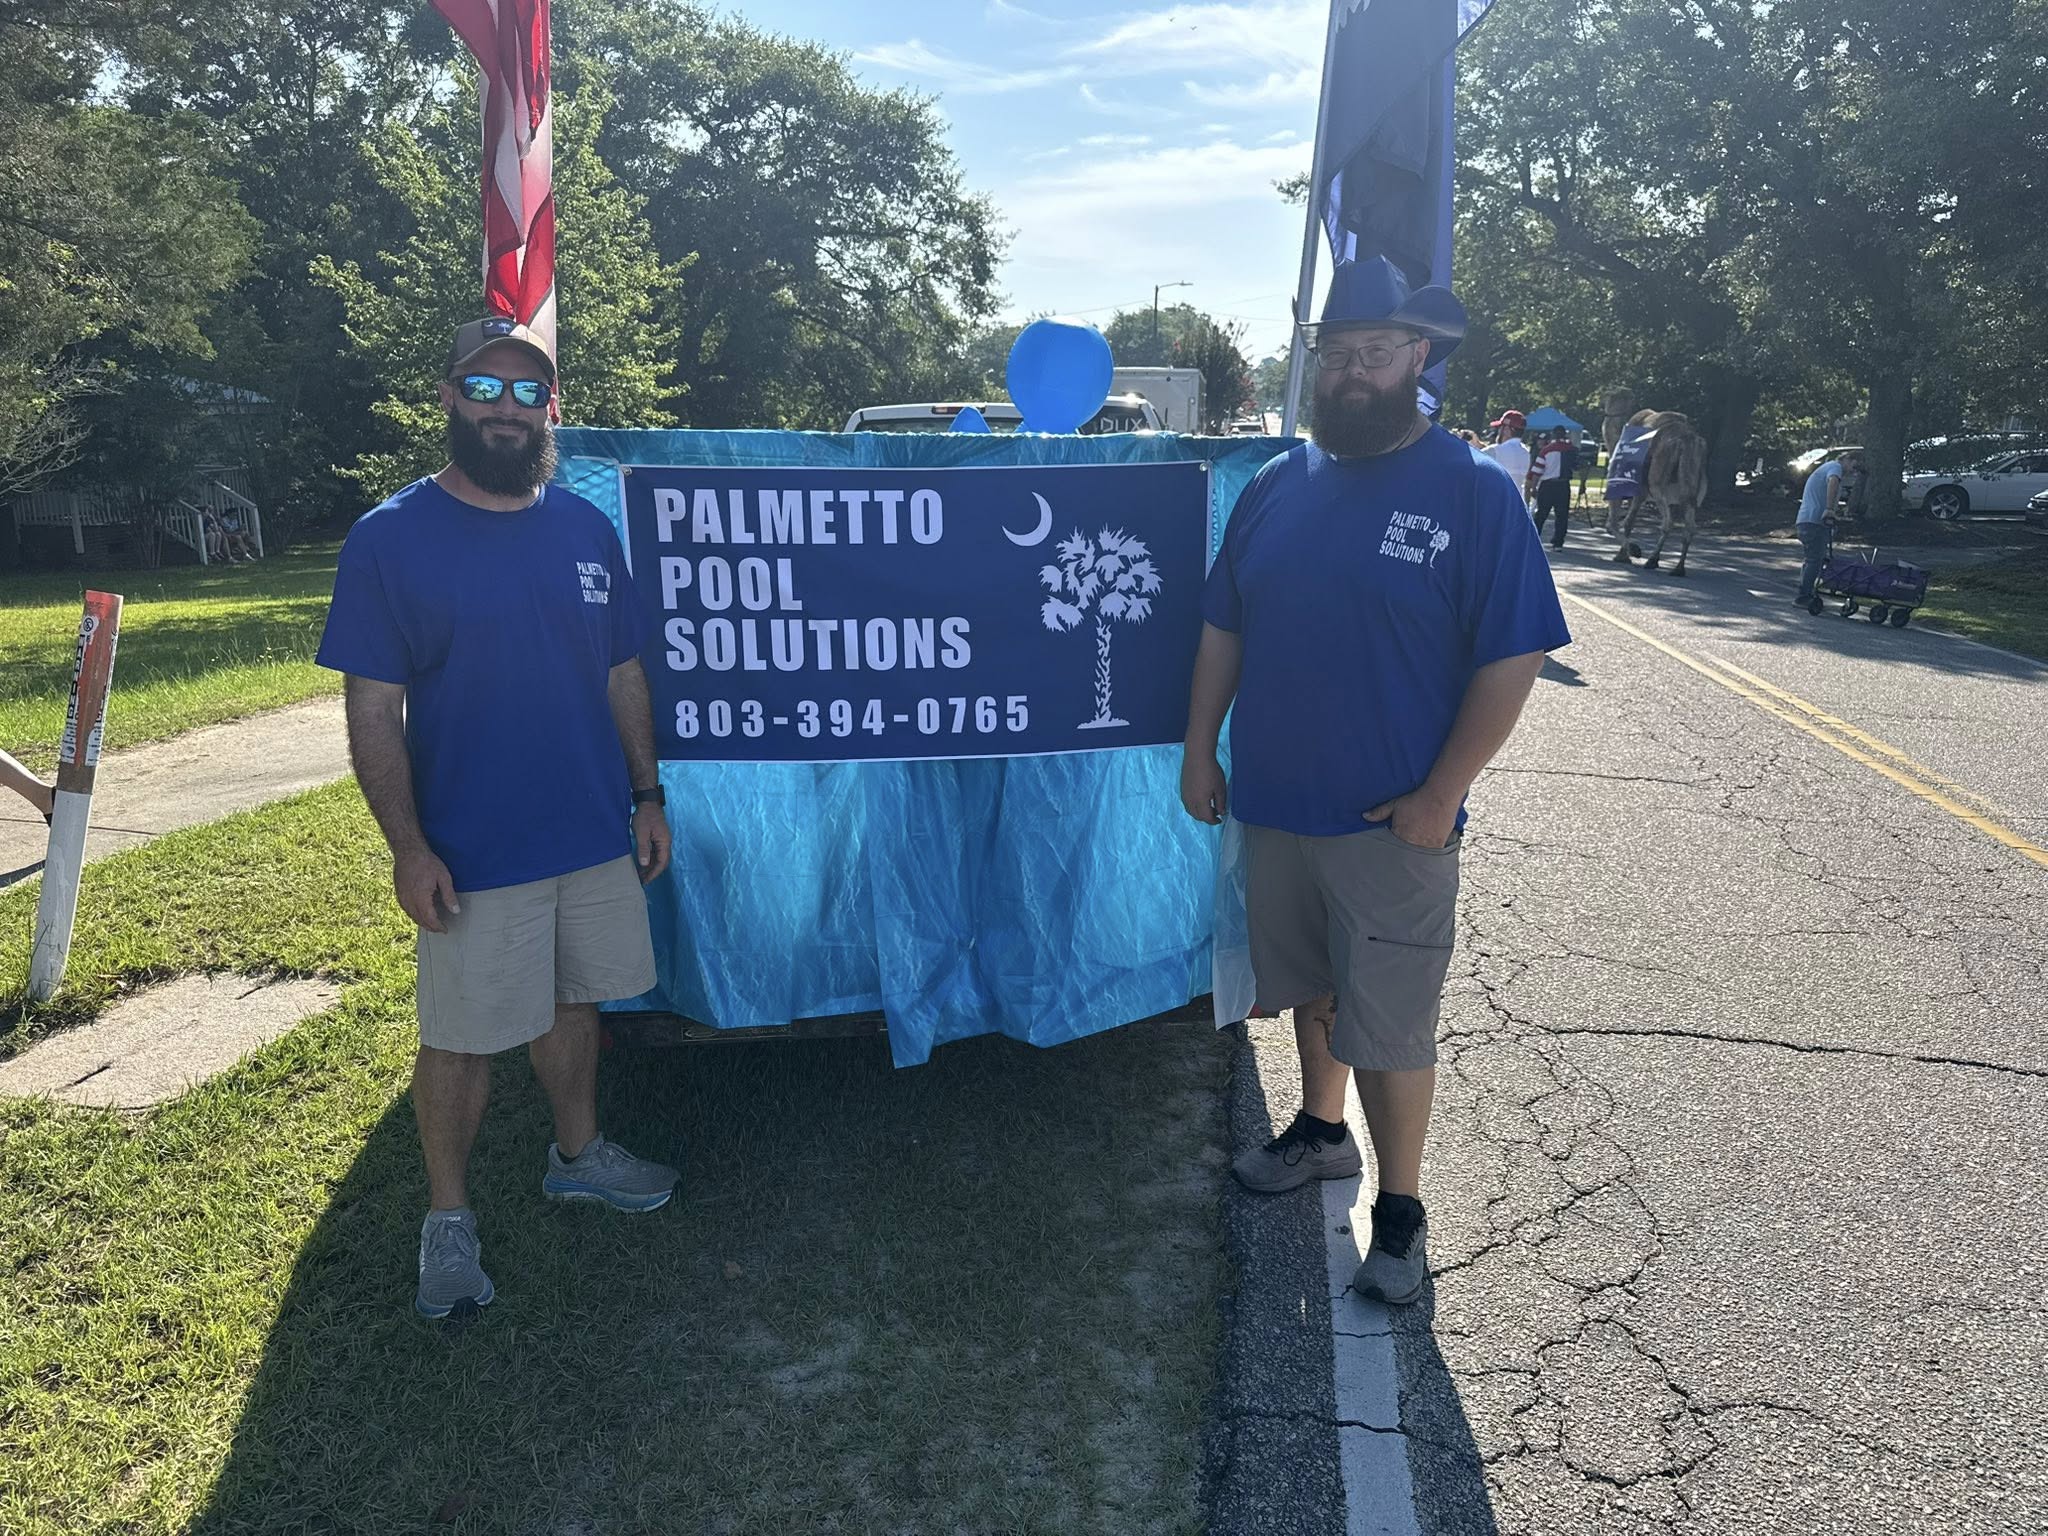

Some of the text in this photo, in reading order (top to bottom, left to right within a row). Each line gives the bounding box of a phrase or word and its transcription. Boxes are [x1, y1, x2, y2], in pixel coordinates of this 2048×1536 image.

[653, 488, 944, 545] PALMETTO
[1384, 526, 1407, 543] POOL
[1389, 511, 1431, 531] PALMETTO
[1379, 540, 1425, 564] SOLUTIONS
[660, 556, 803, 611] POOL
[664, 616, 972, 672] SOLUTIONS
[675, 695, 1030, 738] 803-394-0765
